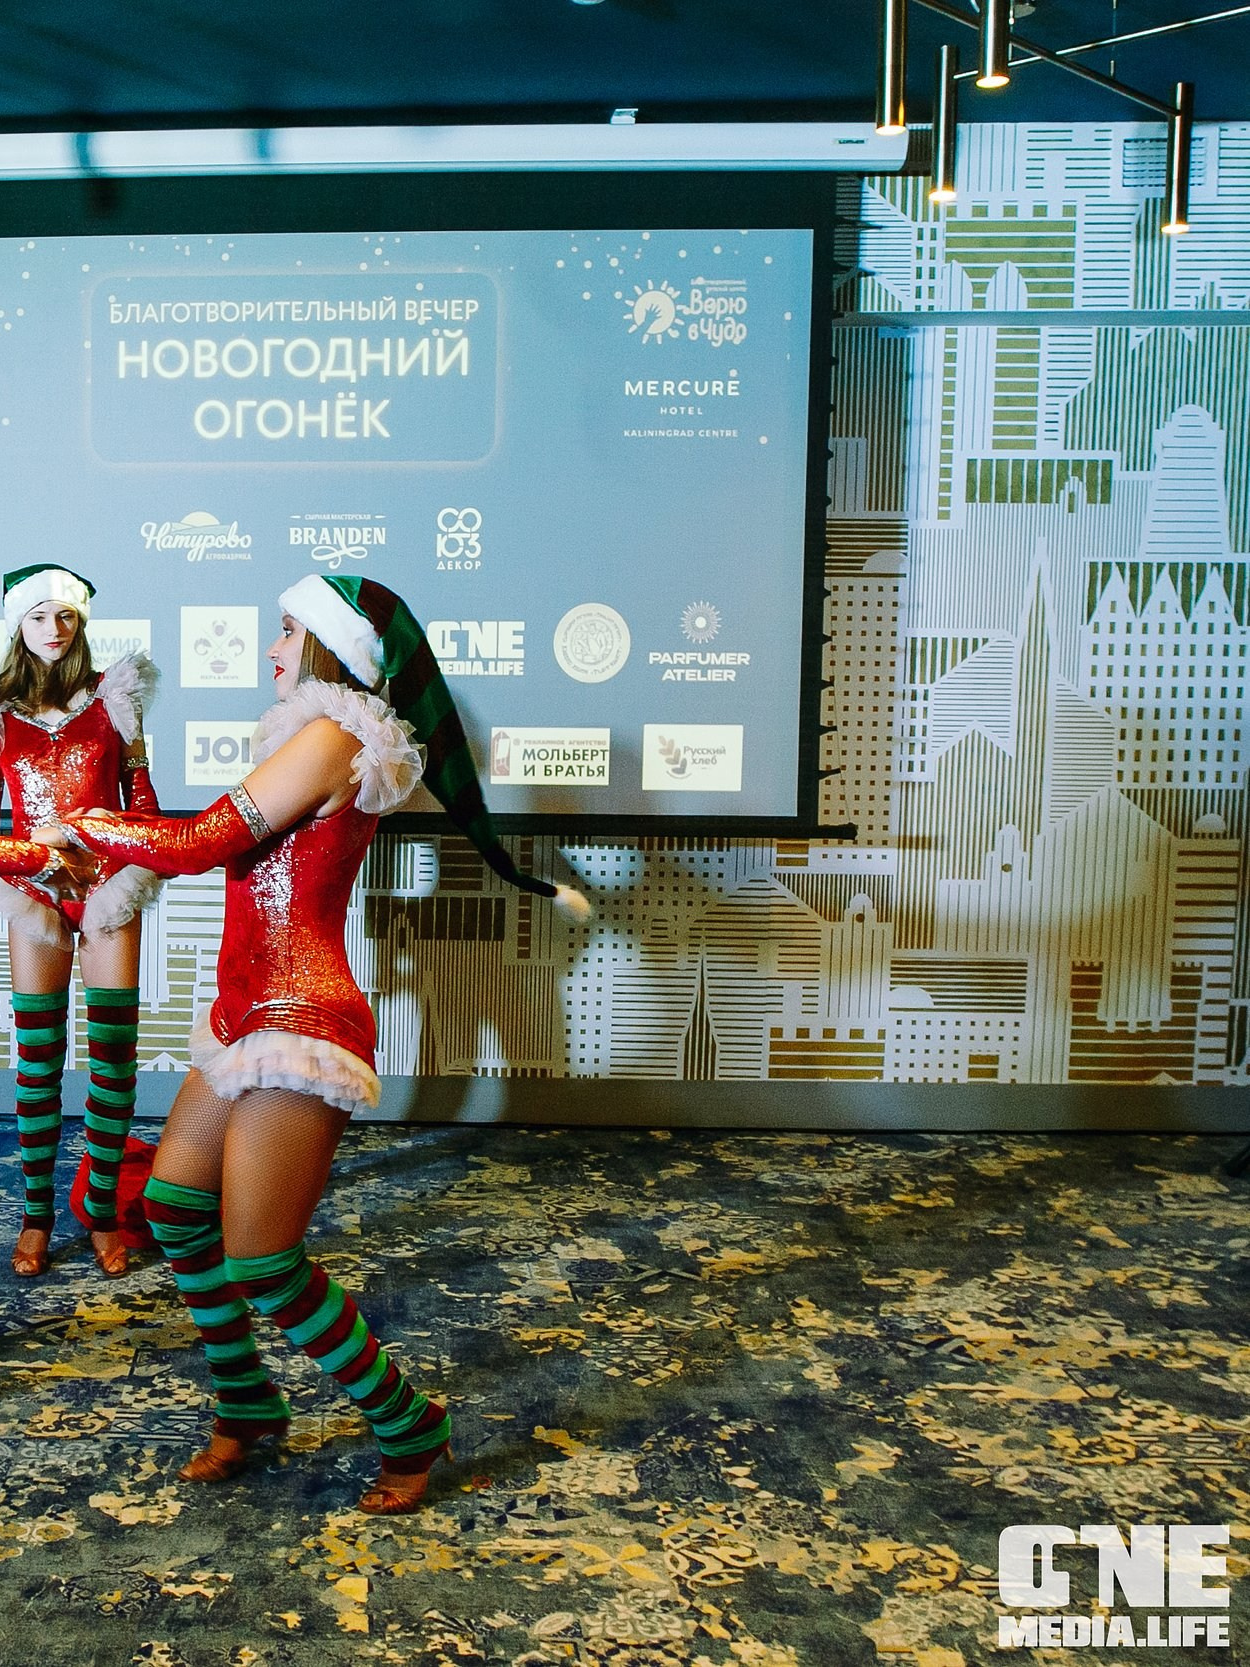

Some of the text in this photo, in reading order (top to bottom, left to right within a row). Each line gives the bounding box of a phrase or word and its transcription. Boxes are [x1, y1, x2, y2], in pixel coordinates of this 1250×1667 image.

[109, 296, 480, 324] БЛАГОТВОРИТЕЛЬНЫЙ ВЕЧЕР
[690, 288, 747, 320] Верю
[688, 323, 699, 341] в
[118, 329, 470, 383] НОВОГОДНИЙ
[624, 380, 740, 396] MERCURE
[194, 392, 391, 439] ОГОНЁК
[660, 406, 703, 415] HOTEL
[623, 429, 738, 438] KALININGRAD CENTRE
[140, 520, 252, 562] Натурово
[290, 527, 386, 553] BRANDEN
[436, 561, 482, 570] ДЕКОР
[649, 652, 750, 665] PARFUMER
[661, 669, 736, 681] ATELIER
[522, 748, 609, 761] МОЛЬБЕРТ
[683, 745, 726, 756] Русский
[691, 755, 718, 765] хлеб
[524, 765, 606, 777] И БРАТЬЯ
